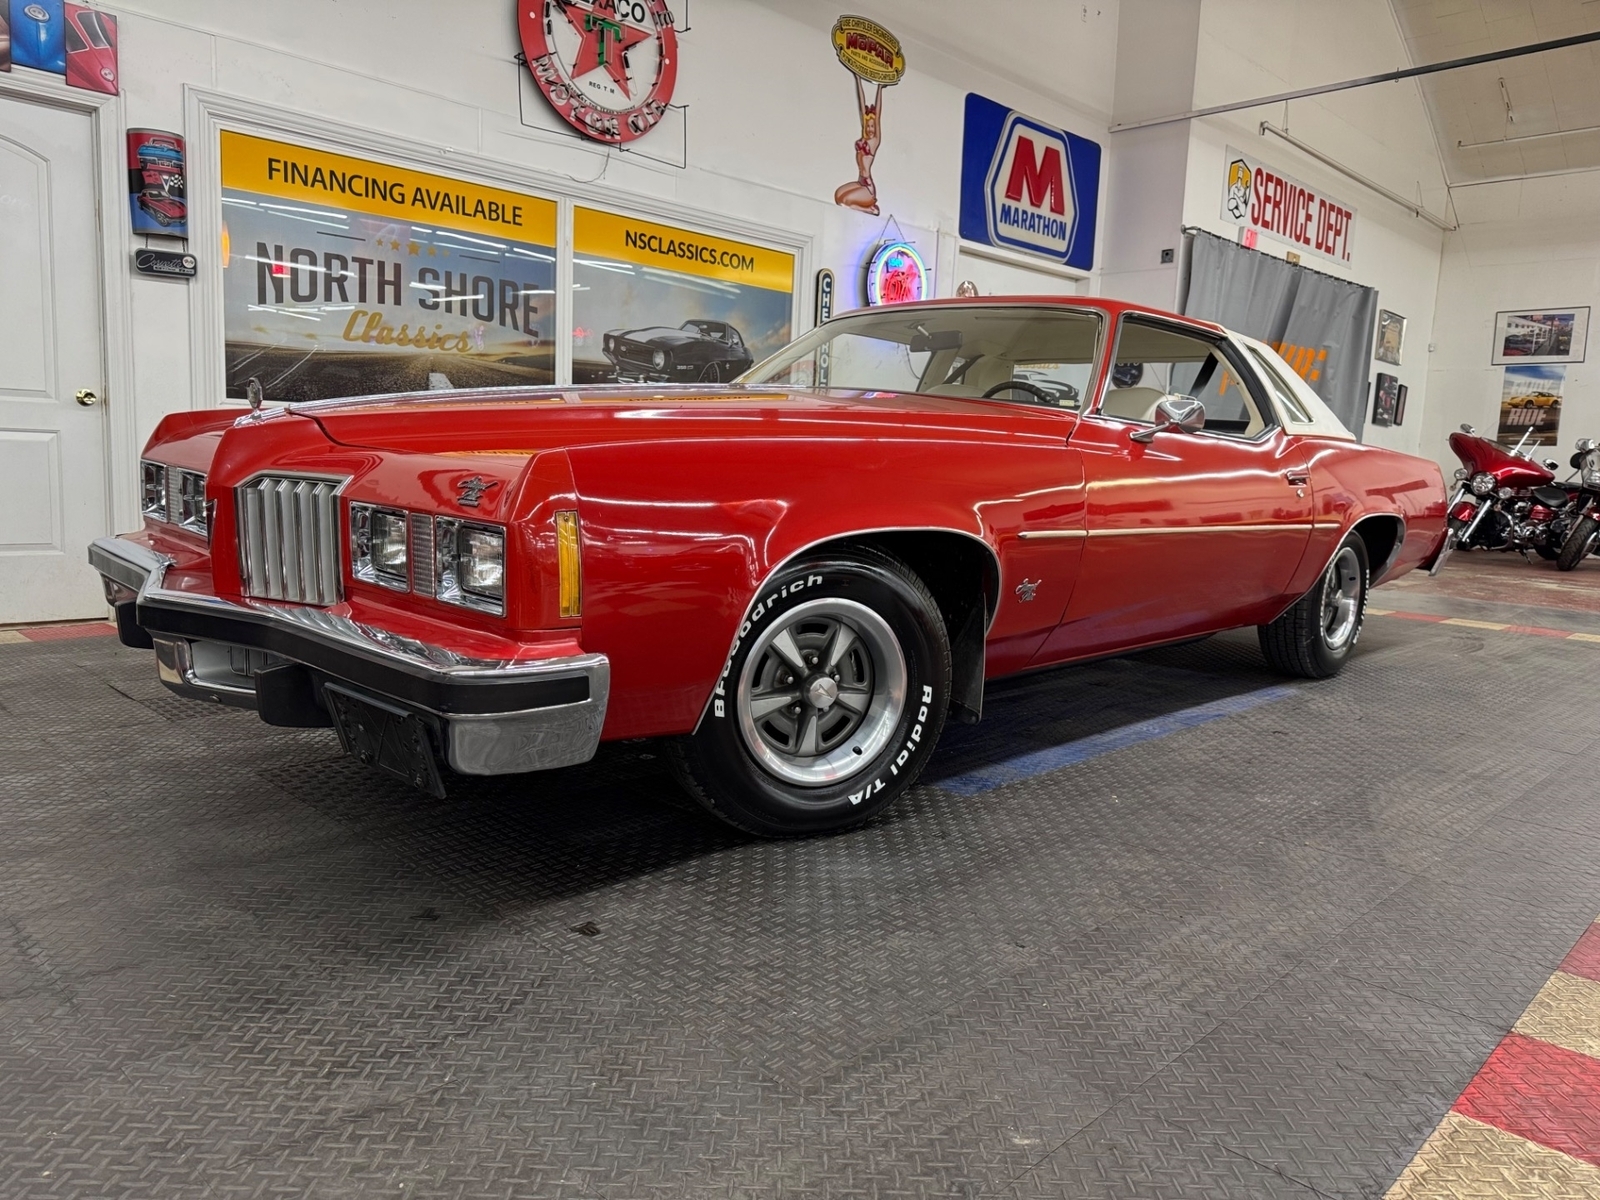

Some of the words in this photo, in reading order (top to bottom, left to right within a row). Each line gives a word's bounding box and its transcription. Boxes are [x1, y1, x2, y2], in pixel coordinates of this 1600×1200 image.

[267, 157, 405, 205] FINANCING
[411, 187, 523, 227] AVAILABLE
[1005, 135, 1065, 217] M
[1000, 203, 1067, 241] MARATHON
[1251, 167, 1315, 247] SERVICE
[1315, 198, 1353, 262] DEPT.
[625, 229, 755, 273] NSCLASSICS.COM
[256, 242, 402, 306] NORTH
[418, 267, 540, 339] SHORE
[342, 309, 475, 353] Classics
[1506, 408, 1548, 426] RIDE
[890, 685, 933, 776] Radial
[847, 778, 886, 806] T/A
